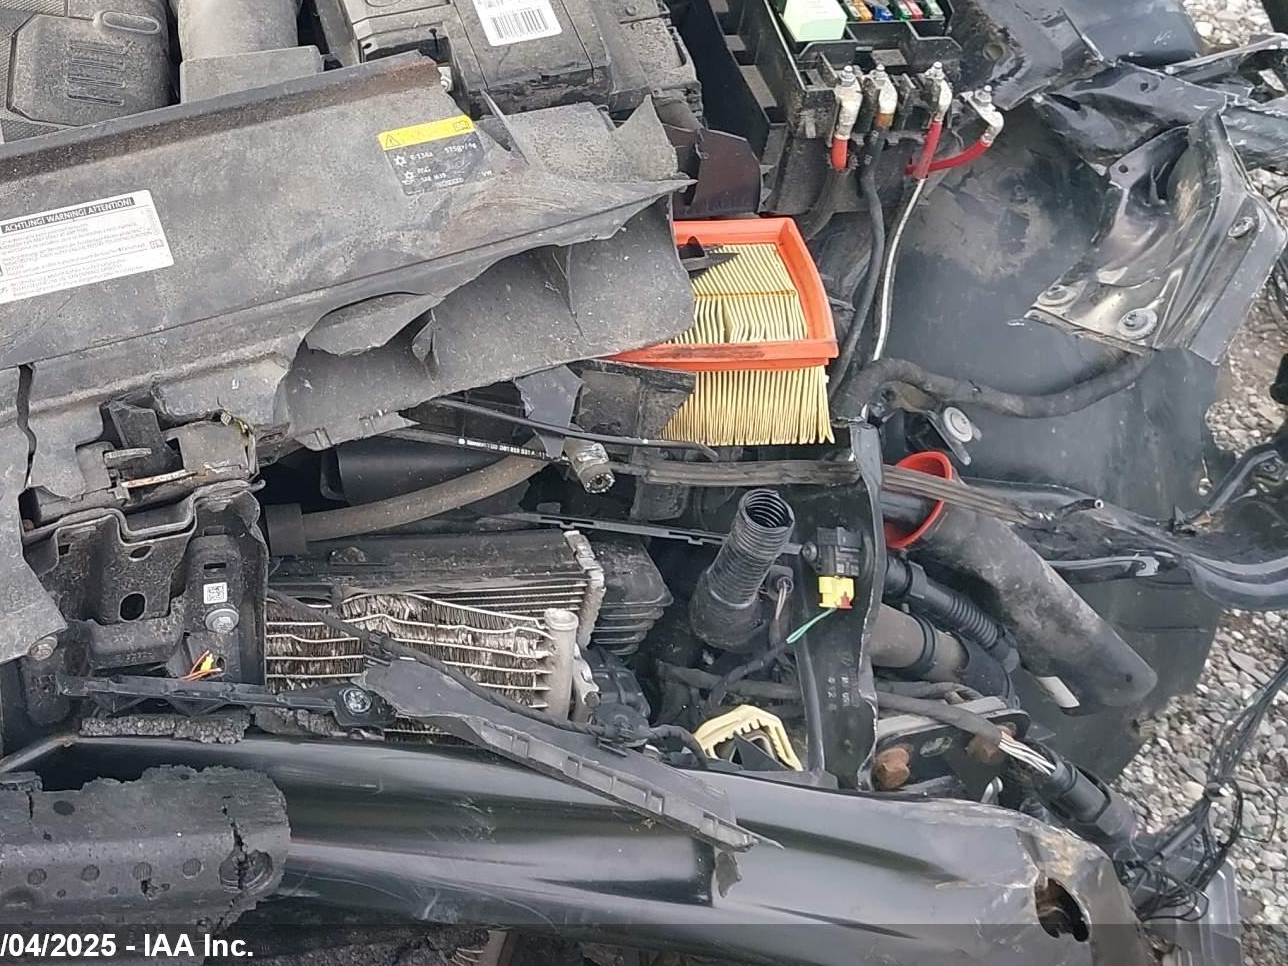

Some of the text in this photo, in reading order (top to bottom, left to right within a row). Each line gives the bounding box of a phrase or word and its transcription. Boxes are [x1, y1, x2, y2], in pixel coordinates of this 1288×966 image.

[4, 199, 132, 232] ACHTUNG! WARNING! ATTENTION!
